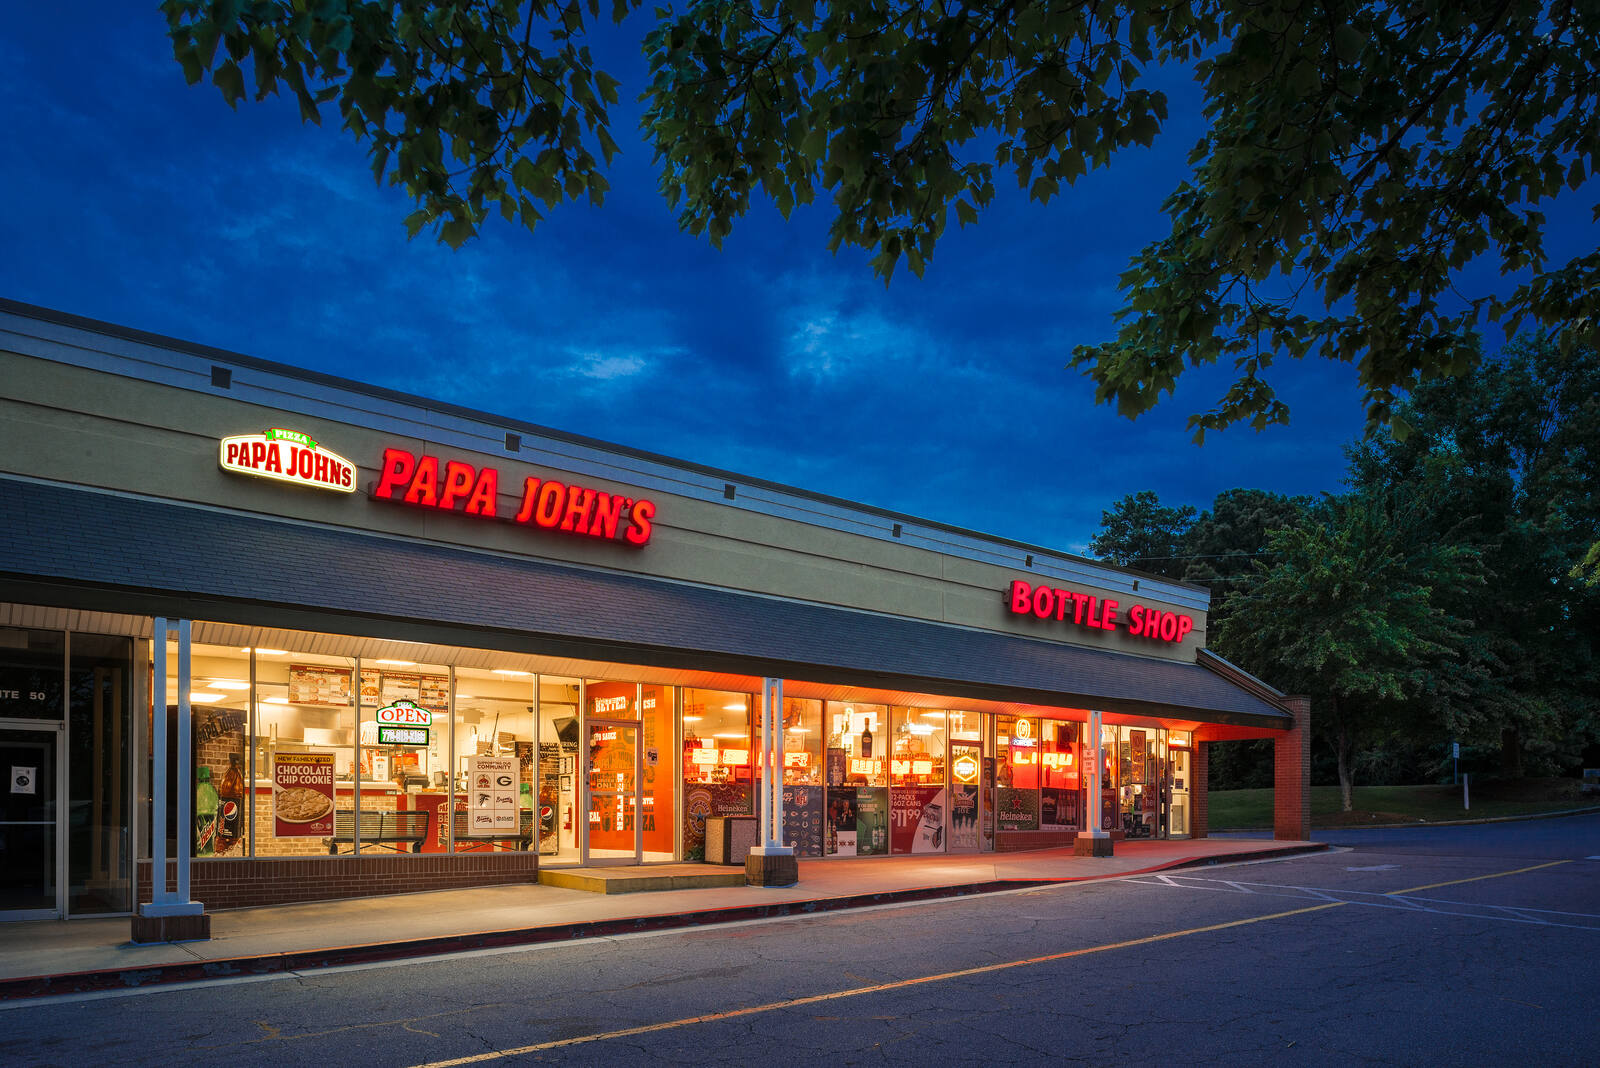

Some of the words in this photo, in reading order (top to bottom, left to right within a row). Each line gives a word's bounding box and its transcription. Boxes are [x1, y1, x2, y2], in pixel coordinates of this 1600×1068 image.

[275, 428, 308, 444] PIZZA
[227, 442, 282, 474] PAPA
[375, 448, 498, 517] PAPA
[516, 476, 656, 545] JOHN'S
[1011, 580, 1119, 632] BOTTLE
[1129, 604, 1193, 644] SHOP
[29, 691, 46, 701] 50
[381, 708, 428, 723] OPEN
[1014, 751, 1073, 769] LIQU
[277, 765, 332, 776] CHOCOLATE
[277, 775, 298, 785] CHIP
[300, 775, 332, 785] COOKIE
[718, 804, 748, 812] Heineken
[624, 814, 656, 831] PIZA
[1000, 811, 1033, 821] Heineken
